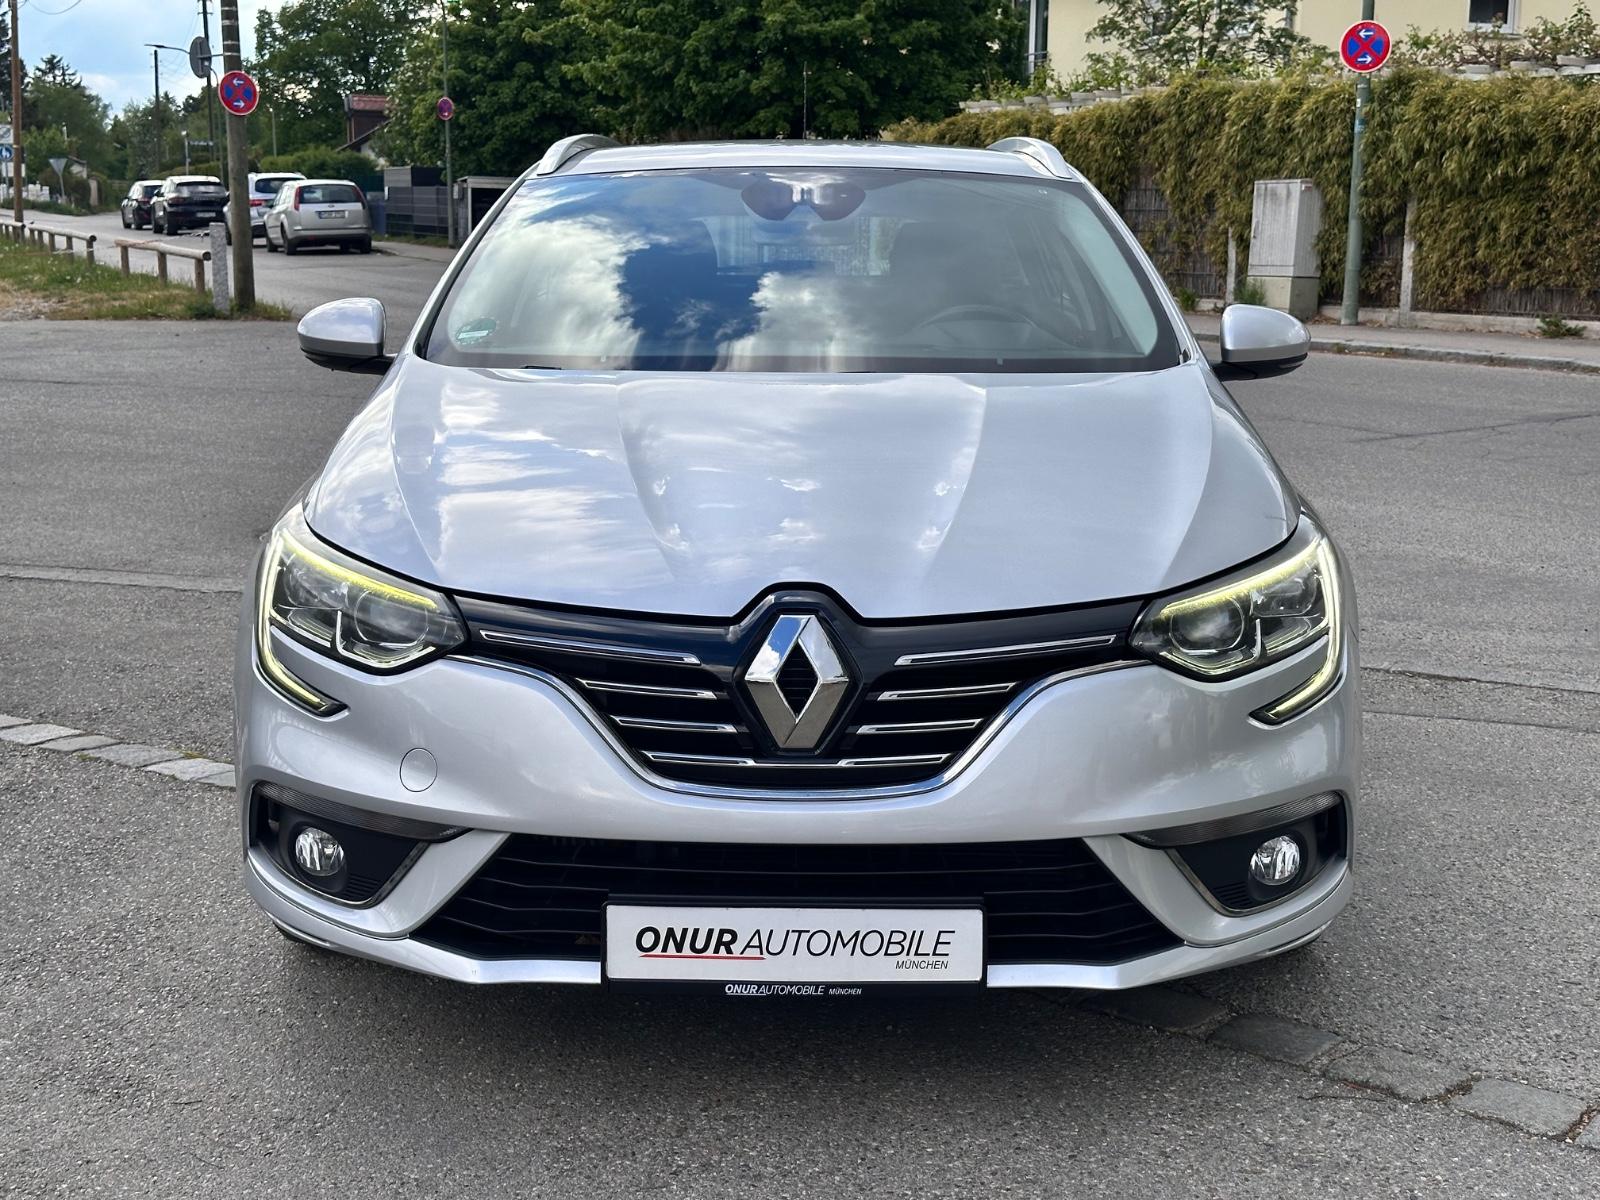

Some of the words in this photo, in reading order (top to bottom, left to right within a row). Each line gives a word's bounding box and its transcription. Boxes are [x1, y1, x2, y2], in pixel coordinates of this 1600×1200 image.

[635, 926, 738, 955] ONUR
[739, 928, 956, 957] AUTOMOBILE
[895, 959, 949, 970] MÜNCHEN
[725, 984, 758, 994] ONUR
[757, 984, 825, 995] AUTOMOBILE
[828, 987, 862, 995] MÜNCHEN
